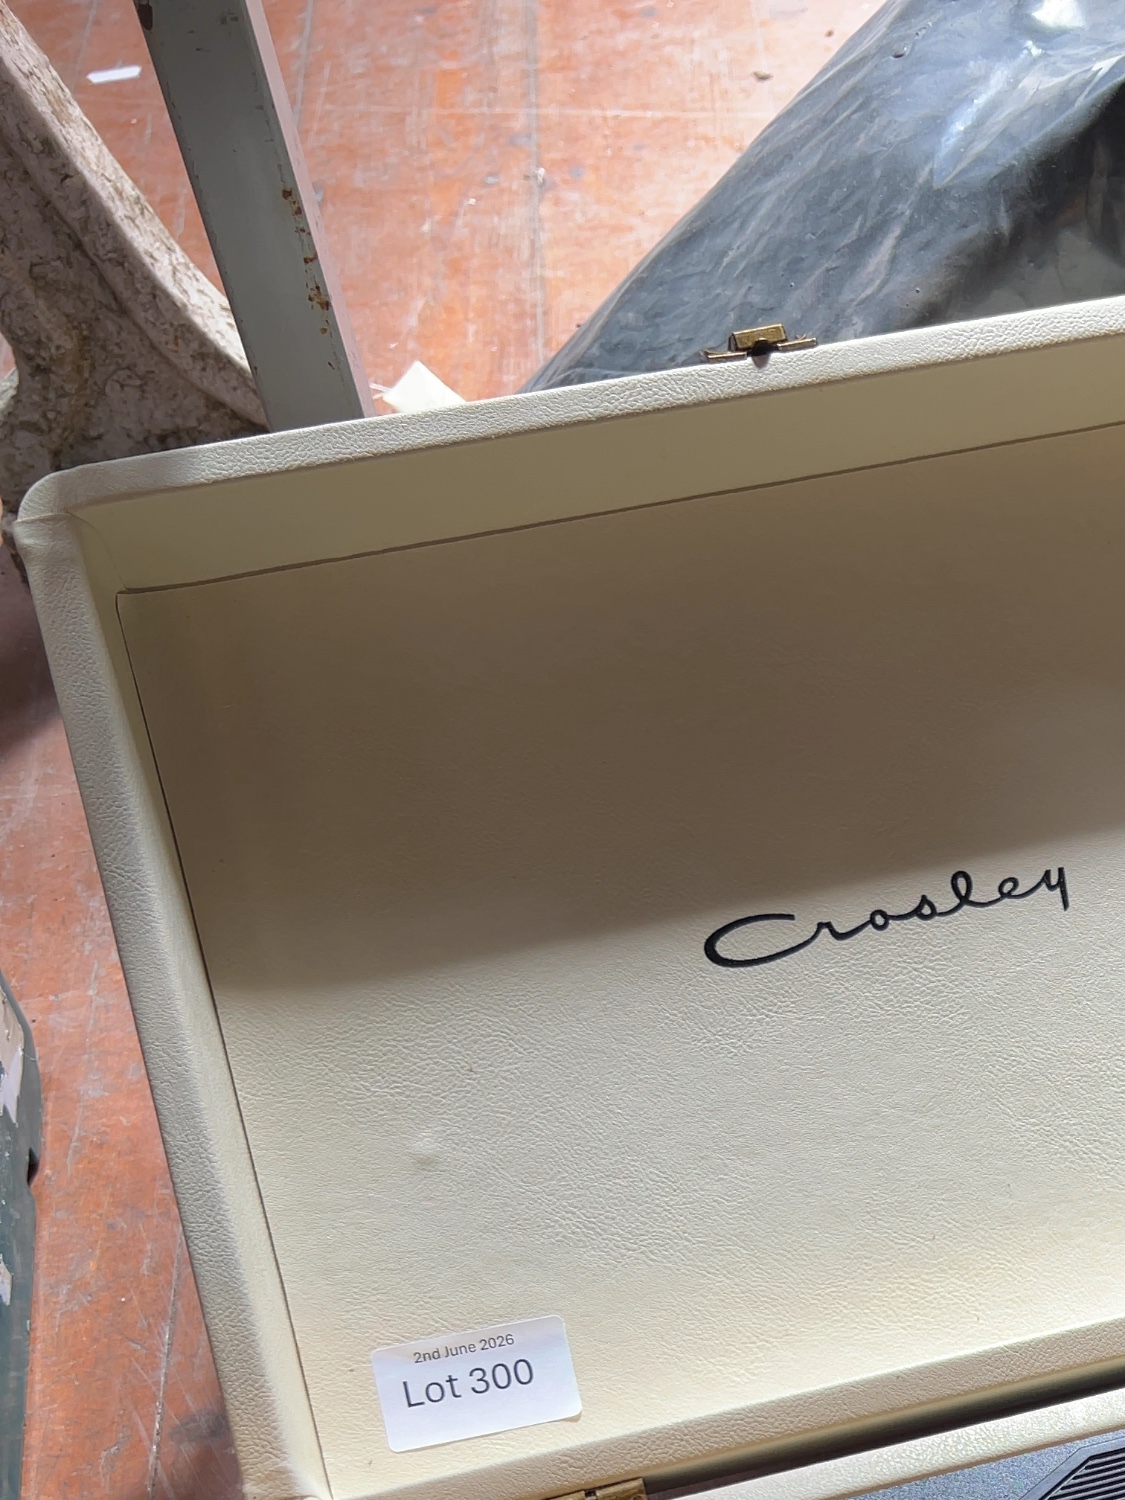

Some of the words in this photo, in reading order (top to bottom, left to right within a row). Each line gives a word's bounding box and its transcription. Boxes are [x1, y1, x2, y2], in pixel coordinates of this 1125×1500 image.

[704, 867, 1069, 968] Crosley
[413, 1348, 442, 1364] 2nd
[444, 1341, 477, 1359] June
[478, 1333, 516, 1352] 2026
[402, 1374, 462, 1408] Lot
[468, 1358, 534, 1394] 300
